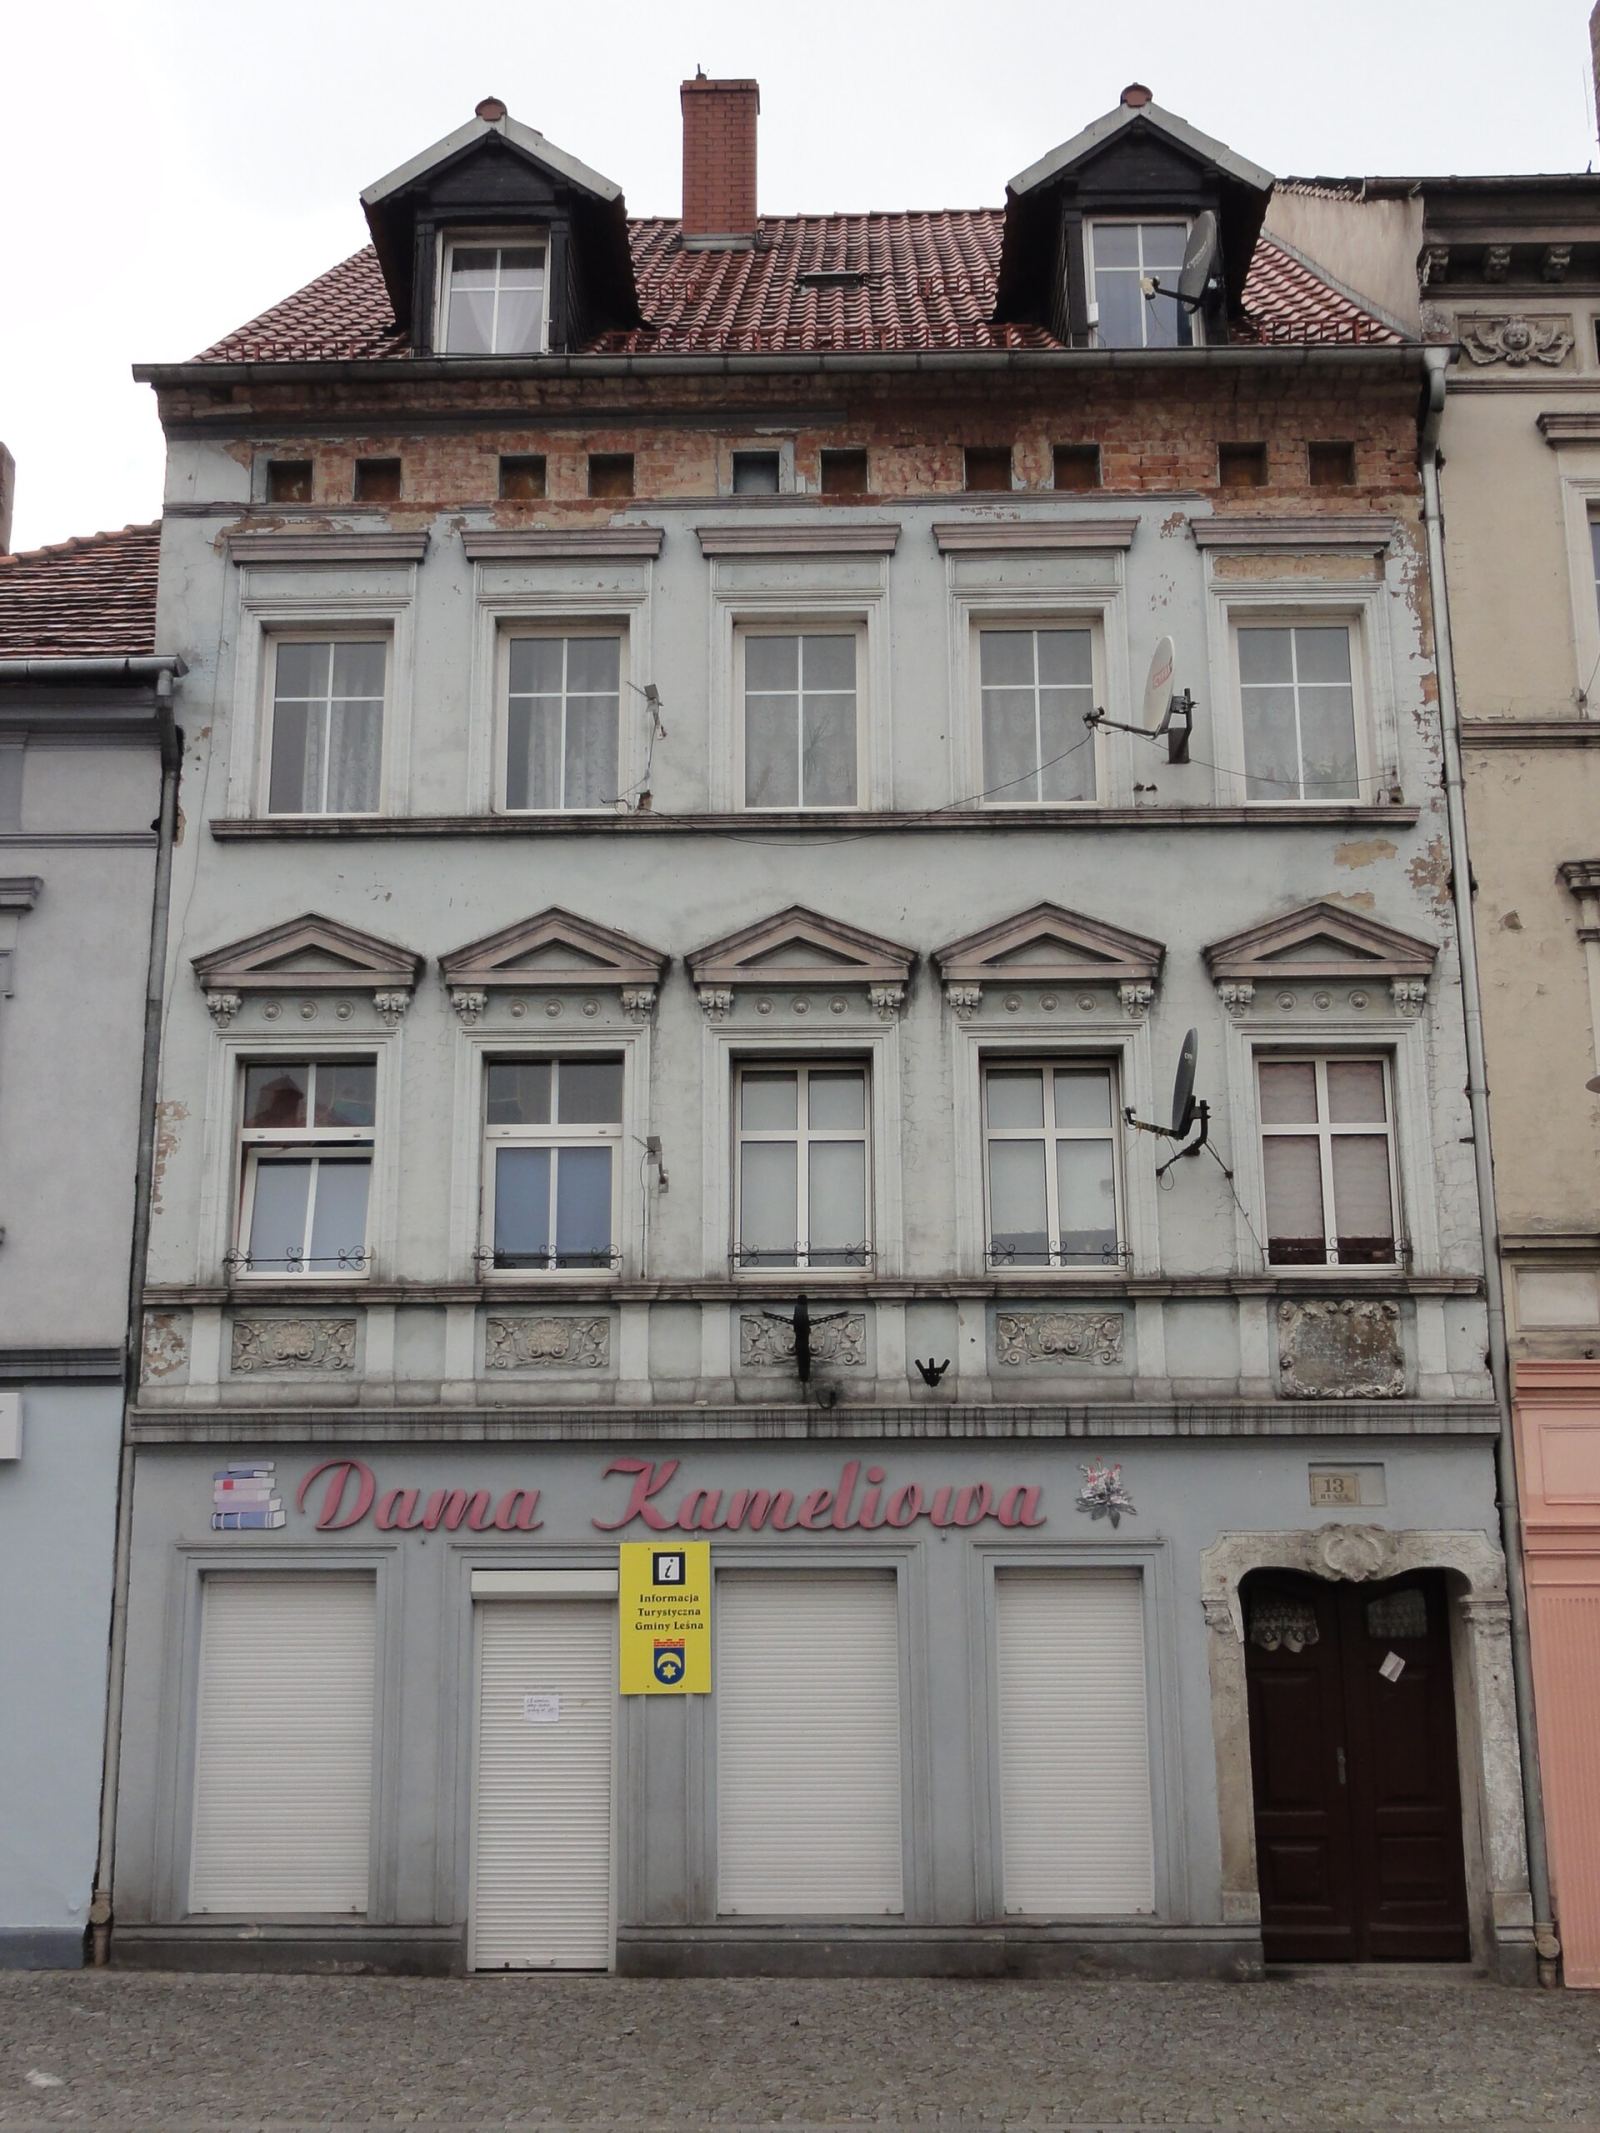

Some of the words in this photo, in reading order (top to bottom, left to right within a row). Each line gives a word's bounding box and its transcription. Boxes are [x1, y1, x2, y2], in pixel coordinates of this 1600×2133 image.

[1324, 1478, 1344, 1493] 13
[297, 1459, 544, 1532] Dama
[592, 1458, 1047, 1531] Kameliowa
[639, 1594, 699, 1603] Informacja
[638, 1608, 701, 1618] Turystyczna
[635, 1622, 670, 1632] Gminy
[674, 1621, 704, 1631] Leśna
